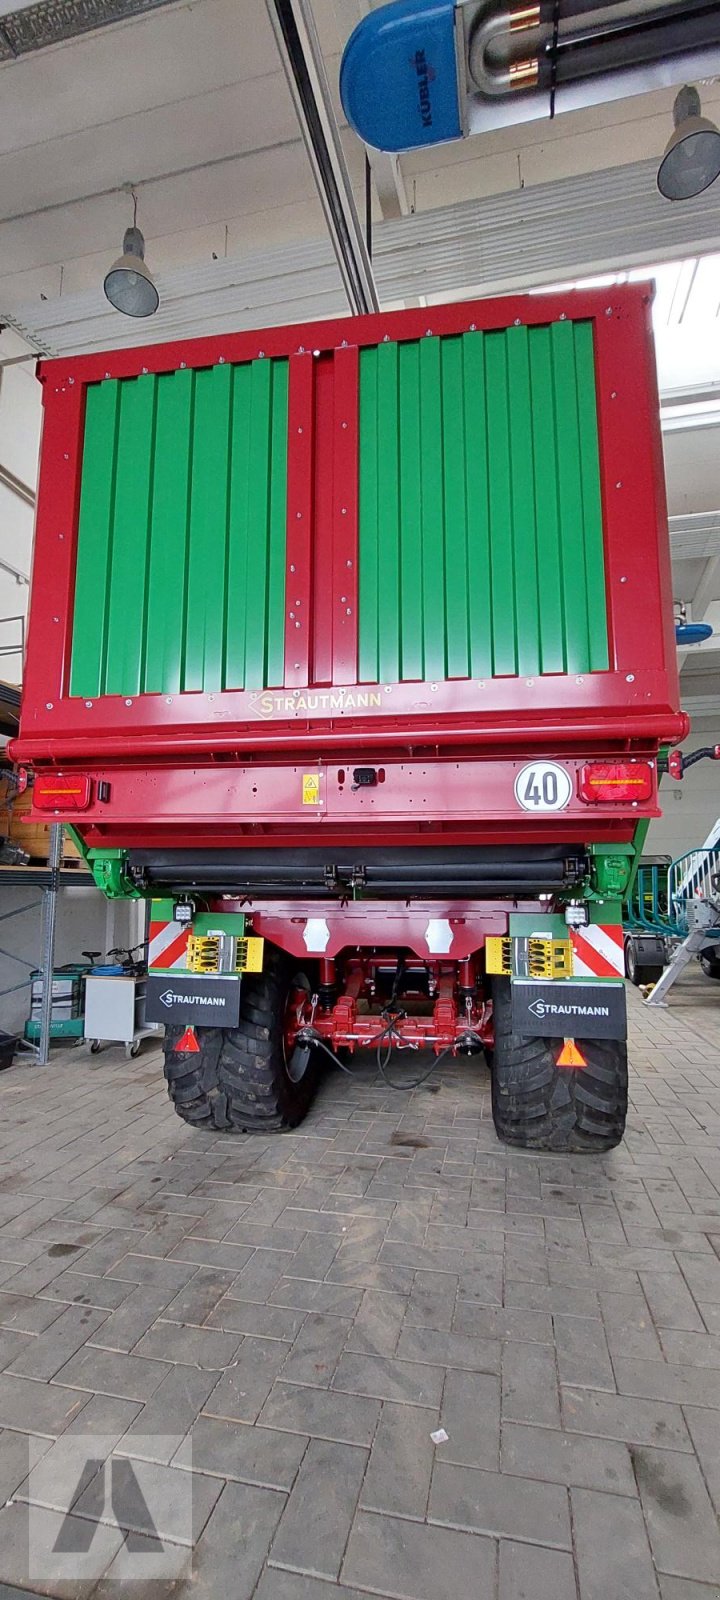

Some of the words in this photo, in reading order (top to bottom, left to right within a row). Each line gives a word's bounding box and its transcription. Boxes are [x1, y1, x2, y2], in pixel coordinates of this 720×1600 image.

[260, 692, 381, 713] STRAUTMANN
[524, 771, 558, 805] 40
[165, 993, 226, 1007] STRAUTMANN
[535, 1003, 609, 1017] STRAUTMANN
